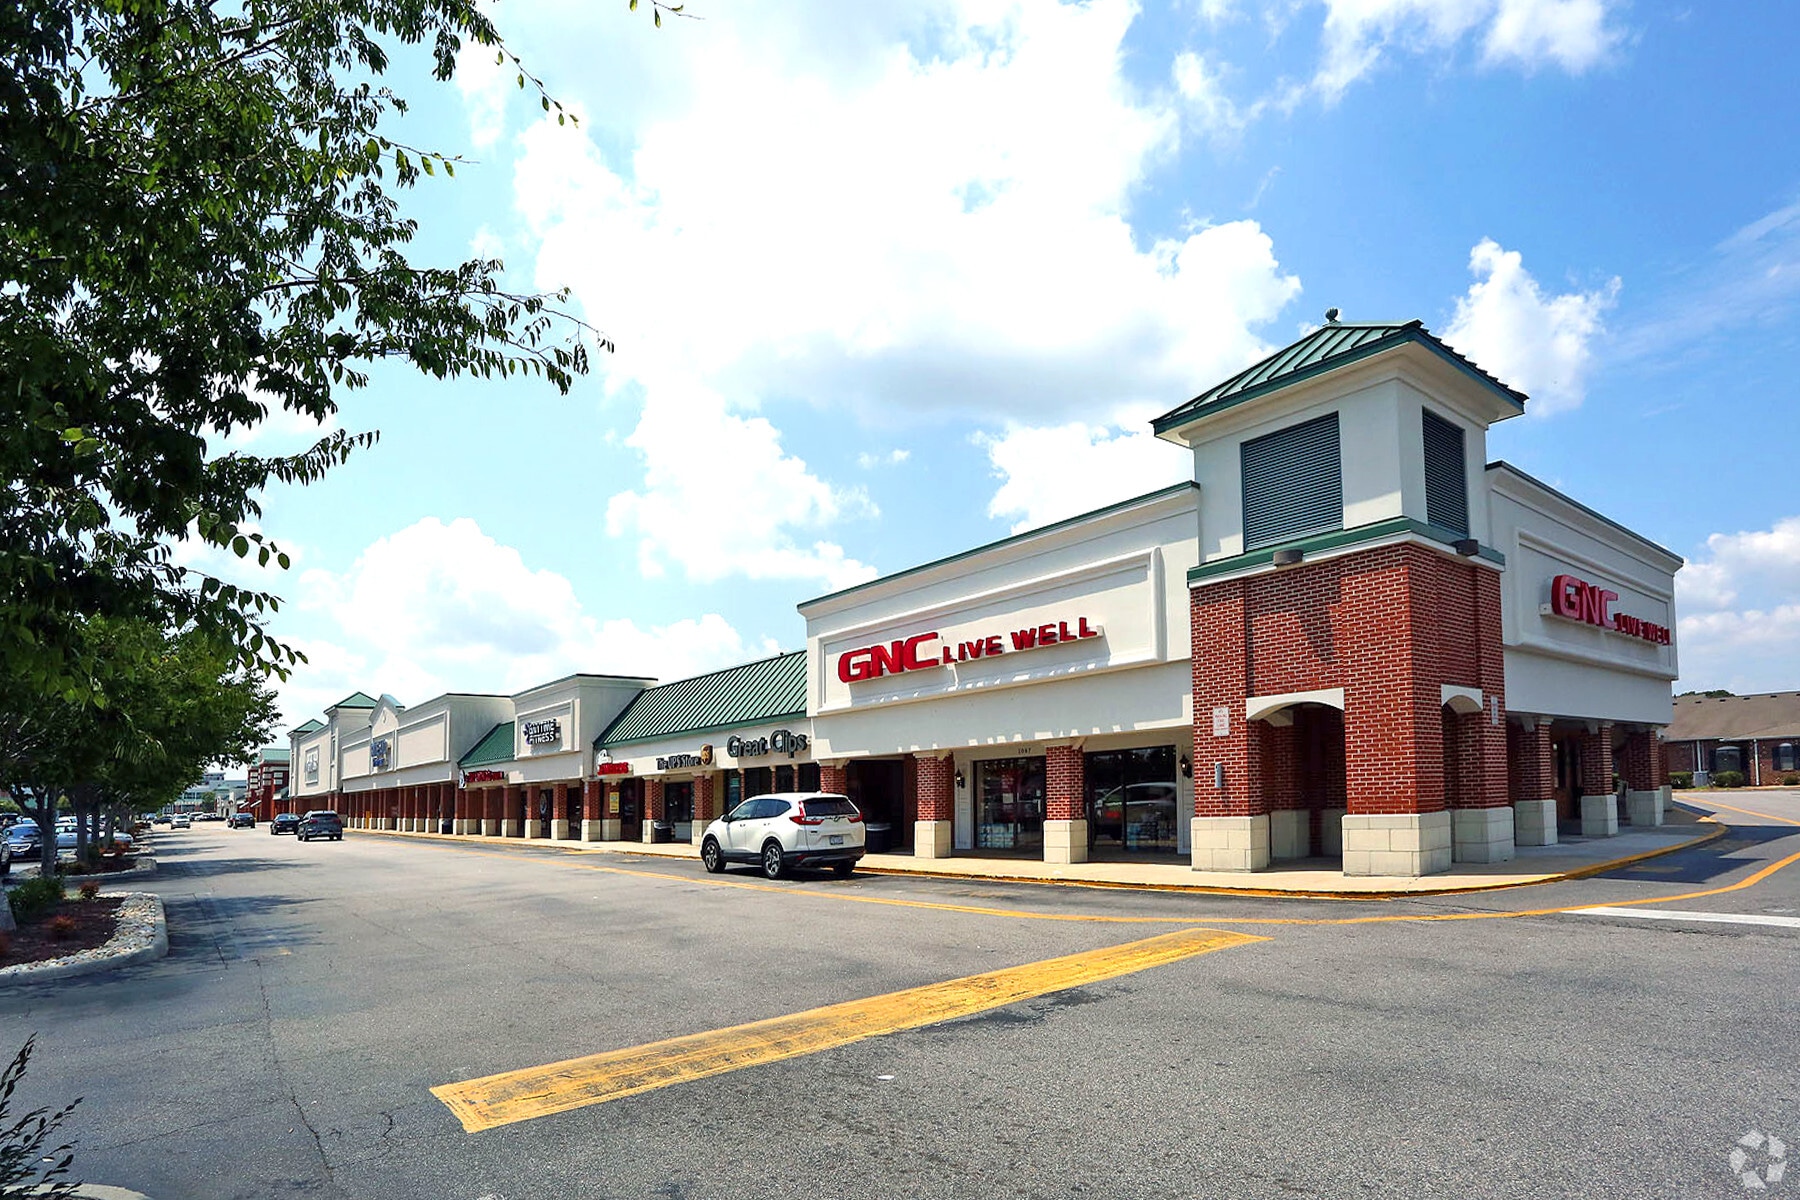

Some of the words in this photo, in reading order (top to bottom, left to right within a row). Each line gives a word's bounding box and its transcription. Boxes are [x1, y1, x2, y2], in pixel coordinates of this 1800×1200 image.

[1551, 574, 1618, 630] GNC
[1614, 612, 1645, 637] LIVE
[838, 631, 941, 683] GNC
[942, 635, 1003, 665] LIVE
[1011, 617, 1099, 651] WELL
[656, 757, 669, 770] The
[669, 755, 681, 769] UPS
[681, 754, 702, 768] Store
[727, 735, 768, 758] Great
[770, 729, 808, 759] Clips
